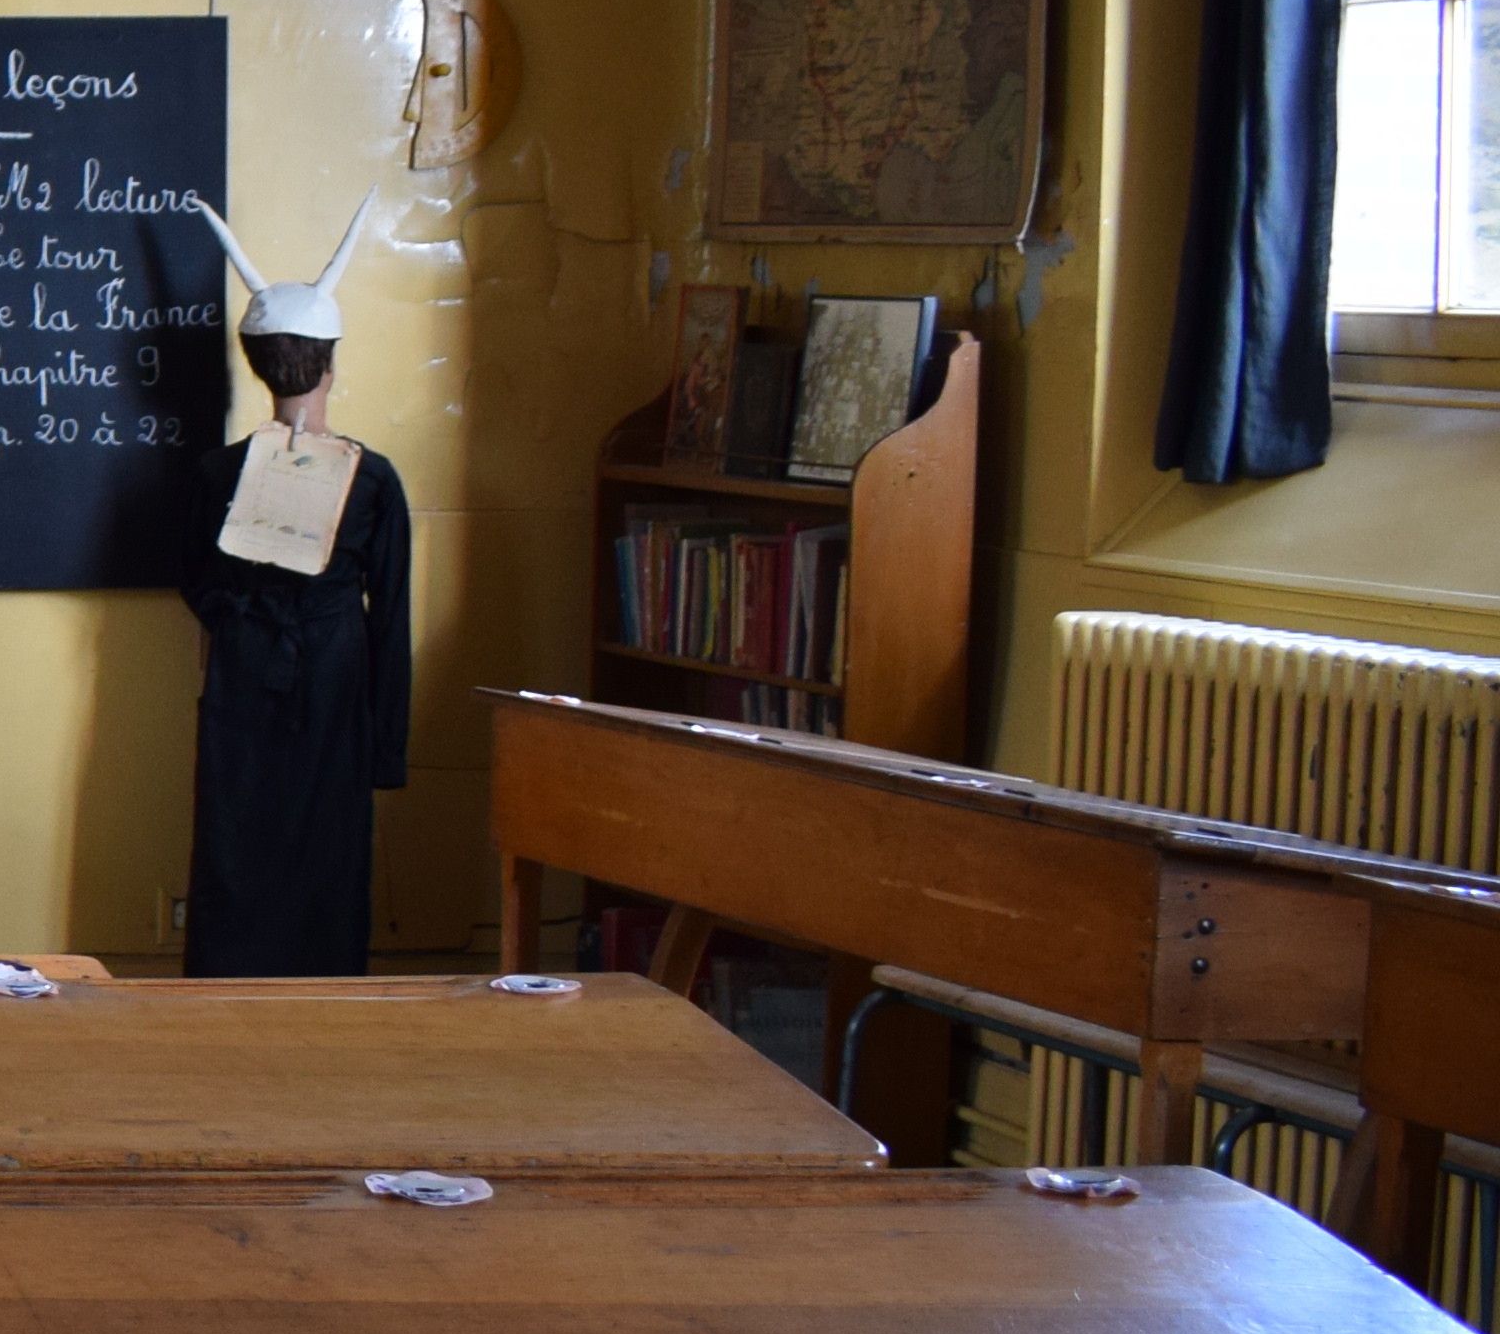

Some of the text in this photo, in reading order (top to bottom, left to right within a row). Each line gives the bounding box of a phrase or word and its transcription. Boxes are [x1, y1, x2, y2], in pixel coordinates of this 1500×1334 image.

[2, 47, 139, 112] leçons
[73, 157, 202, 215] lecture
[35, 233, 124, 273] tour
[28, 280, 80, 332] la
[94, 276, 222, 332] France
[136, 345, 162, 387] 9
[33, 412, 80, 446] 20
[91, 411, 124, 447] à
[135, 414, 186, 447] 22
